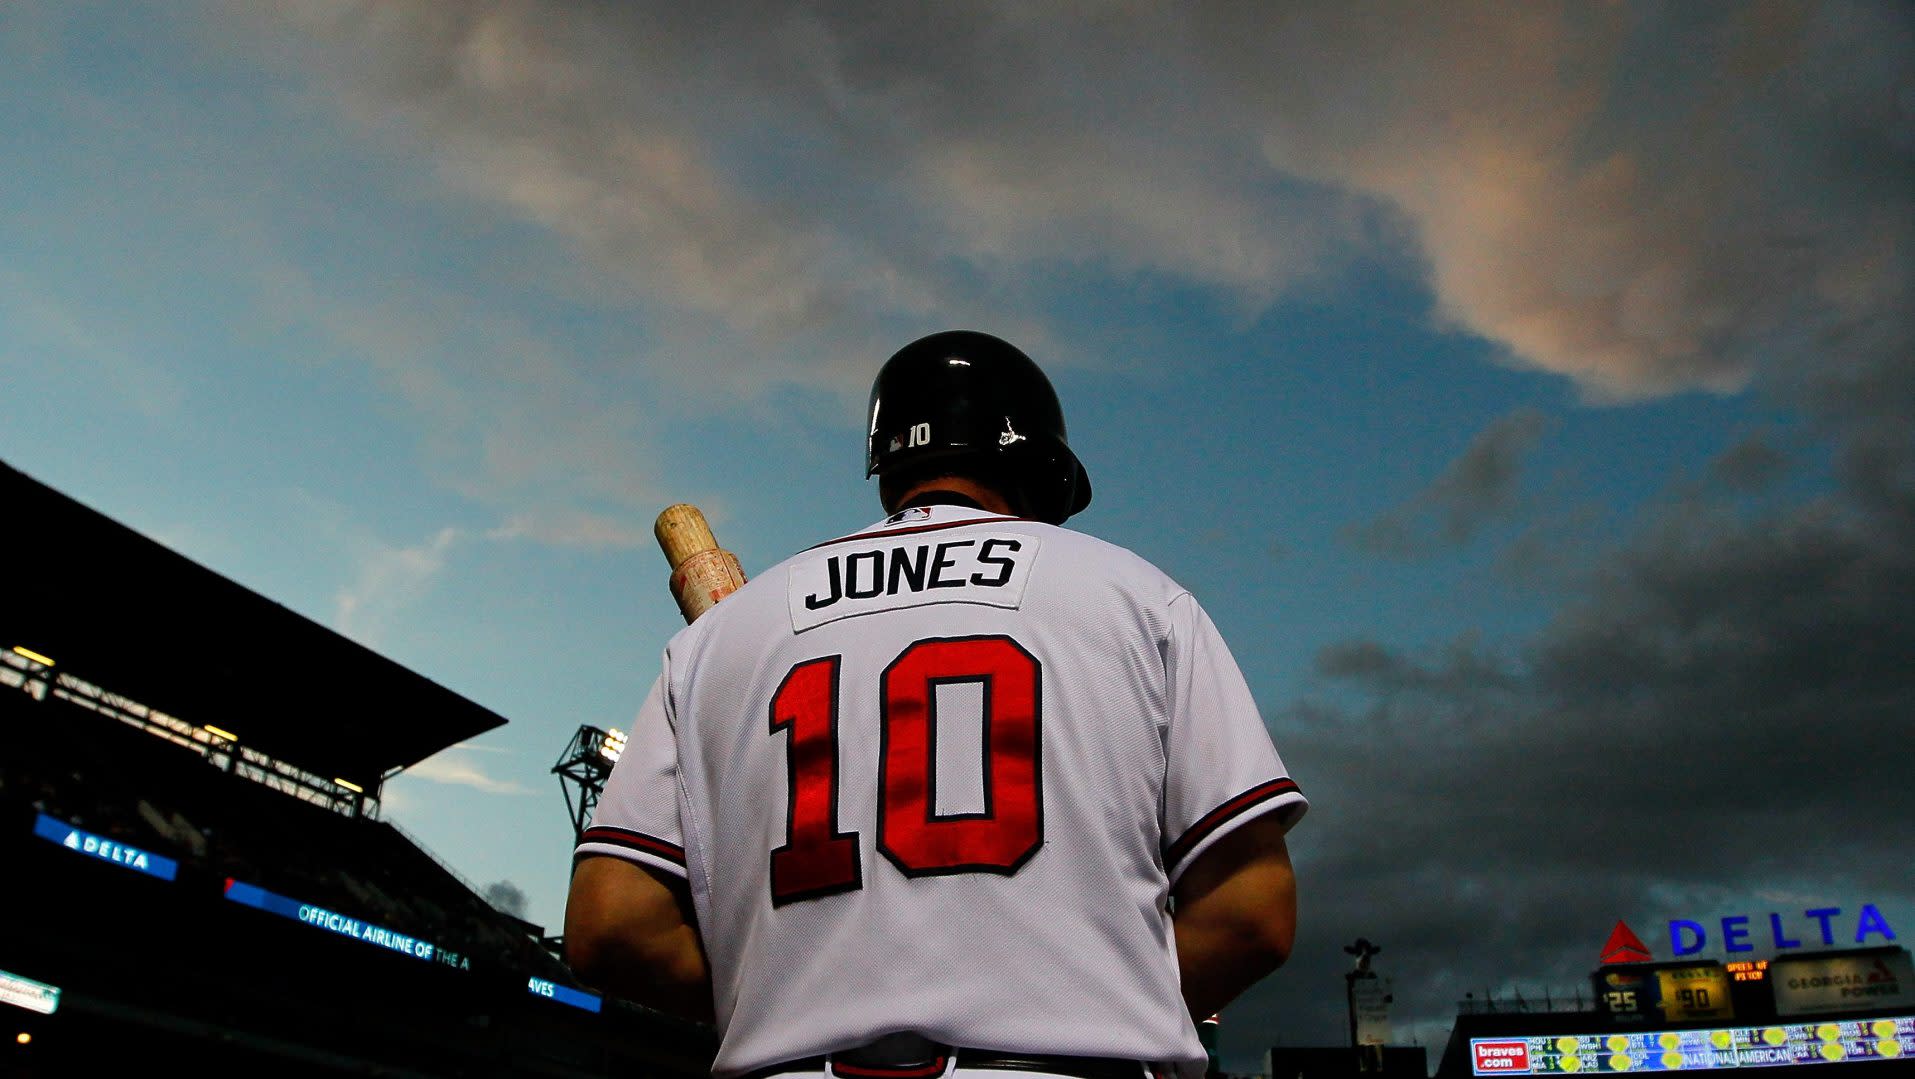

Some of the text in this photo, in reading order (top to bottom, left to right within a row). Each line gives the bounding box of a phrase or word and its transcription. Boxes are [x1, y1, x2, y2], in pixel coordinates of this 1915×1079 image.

[908, 422, 931, 448] 10
[805, 538, 1022, 611] JONES
[769, 634, 1045, 909] 10
[83, 835, 149, 870] DELTA
[298, 904, 361, 939] OFFICIAL
[361, 928, 414, 954] AIRLINE
[414, 941, 433, 959] OF
[434, 948, 458, 969] THE
[1668, 903, 1897, 957] DELTA
[1478, 1046, 1524, 1057] braves
[1480, 1057, 1513, 1068] .com
[1685, 1050, 1736, 1066] NATIONAL
[1739, 1048, 1792, 1063] AMERICAN
